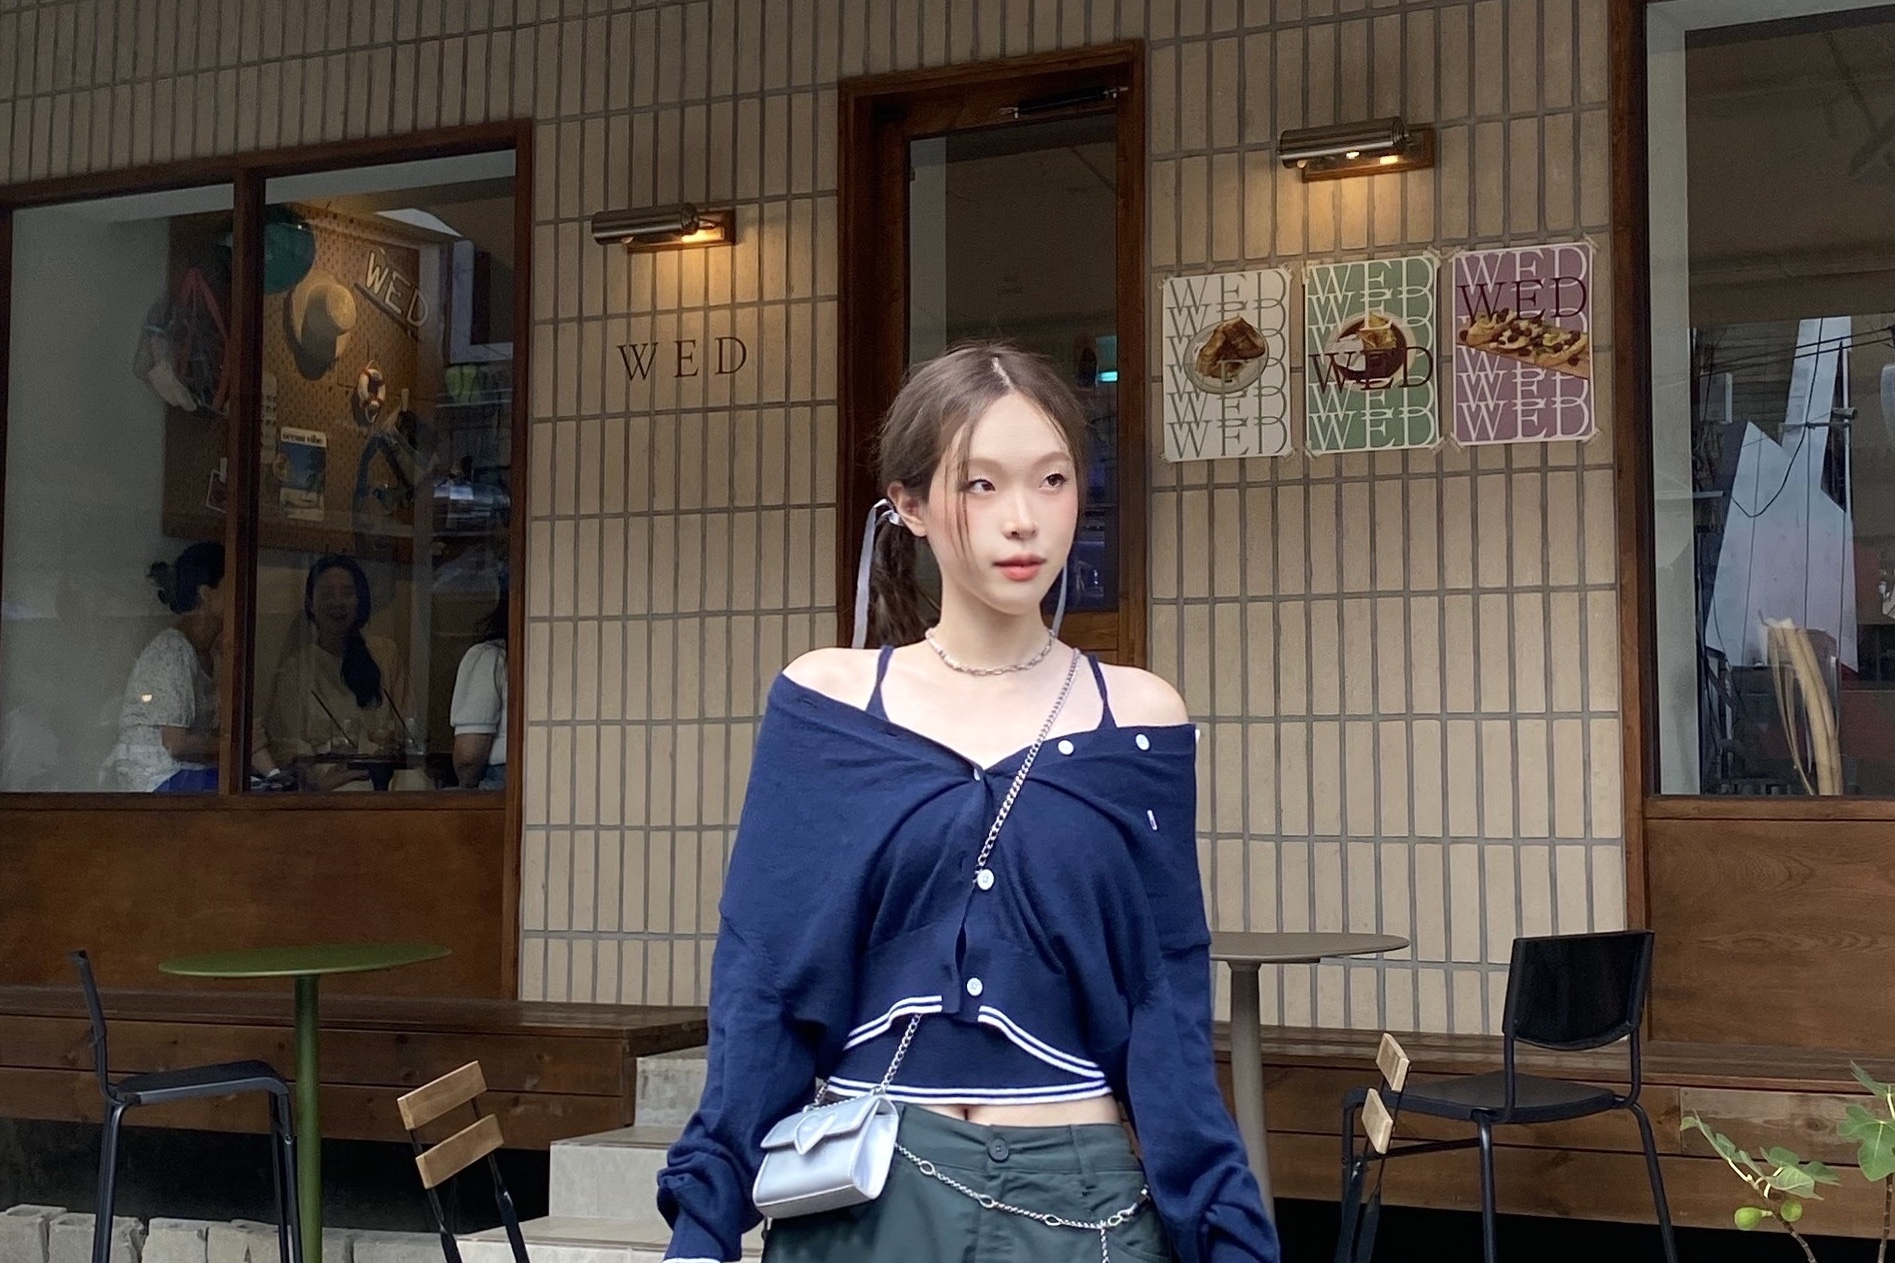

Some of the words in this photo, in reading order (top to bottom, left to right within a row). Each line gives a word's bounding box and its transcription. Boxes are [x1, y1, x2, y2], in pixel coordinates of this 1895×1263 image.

[366, 252, 429, 327] WED
[1168, 270, 1287, 316] WED
[1309, 257, 1434, 305] WED
[1459, 247, 1588, 295] WED
[1457, 276, 1587, 325] WED
[616, 336, 747, 382] WED
[1308, 346, 1434, 394] WED
[1165, 386, 1288, 431] WED
[1309, 407, 1435, 451] WED
[1457, 397, 1590, 441] WED
[1166, 415, 1288, 459] WED
